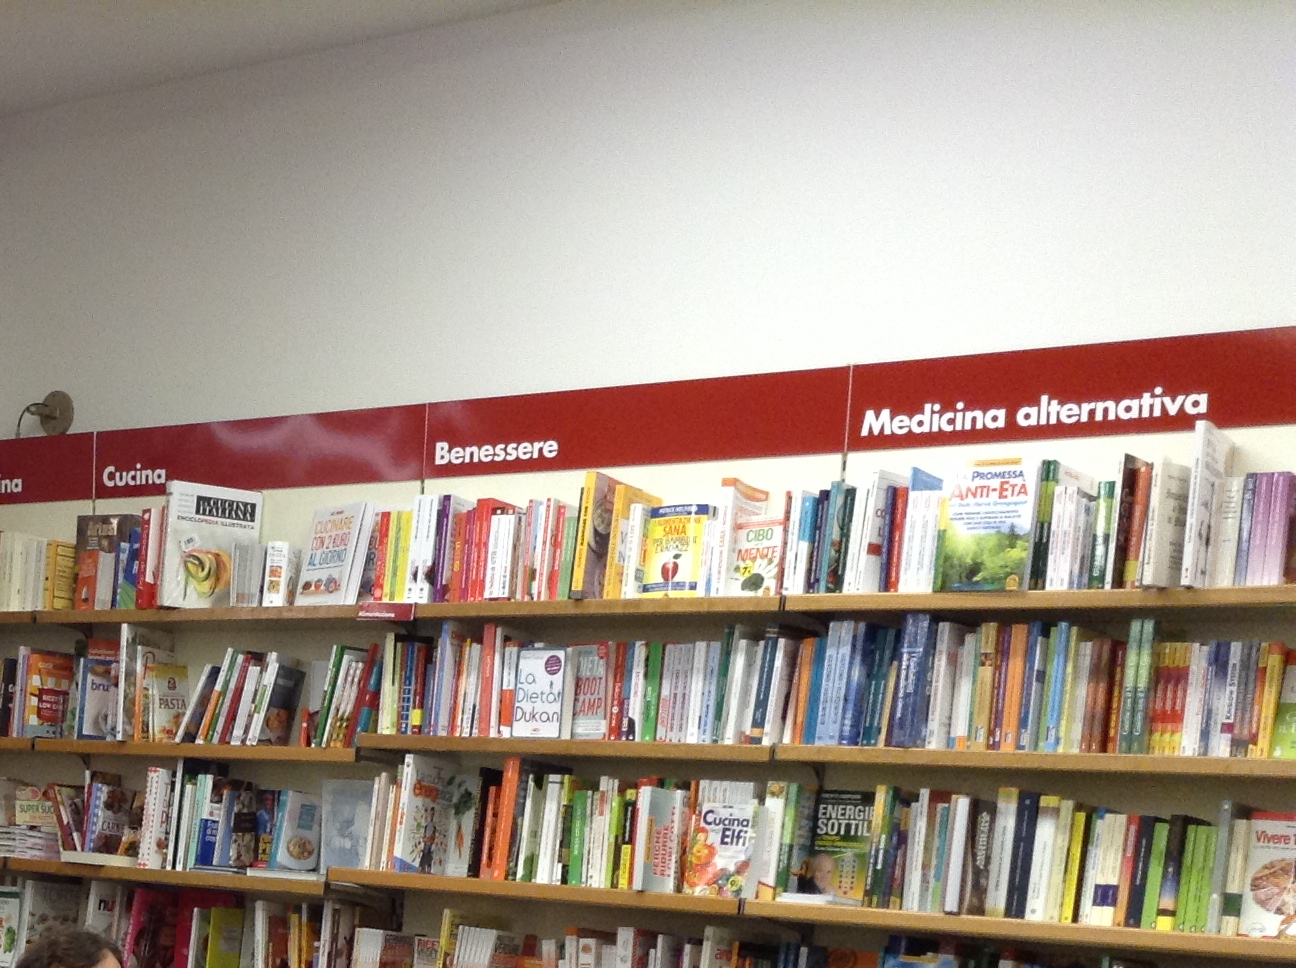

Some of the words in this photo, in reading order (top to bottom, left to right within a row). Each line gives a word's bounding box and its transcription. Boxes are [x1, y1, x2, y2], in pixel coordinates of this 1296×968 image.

[860, 402, 1007, 437] Medicina
[1016, 386, 1209, 428] alternativa
[435, 440, 559, 465] Benessere
[103, 463, 166, 487] Cucina
[199, 506, 251, 521] ITALIANA
[210, 499, 252, 513] CUCINA
[315, 515, 354, 534] CUCINARE
[663, 525, 687, 537] SANA
[311, 536, 326, 551] CON
[325, 535, 333, 549] 2
[332, 532, 351, 548] EURO
[746, 528, 774, 542] CIBO
[307, 552, 317, 567] AL
[318, 548, 348, 566] GIORNO
[737, 545, 779, 561] MENTE
[518, 668, 536, 685] La
[576, 677, 603, 696] BOOT
[159, 697, 187, 710] PASTA
[514, 705, 560, 723] Dukan
[703, 809, 750, 828] Cucina
[815, 818, 871, 838] SOTTIL
[719, 826, 747, 847] Elfi
[1255, 829, 1291, 846] Vivere
